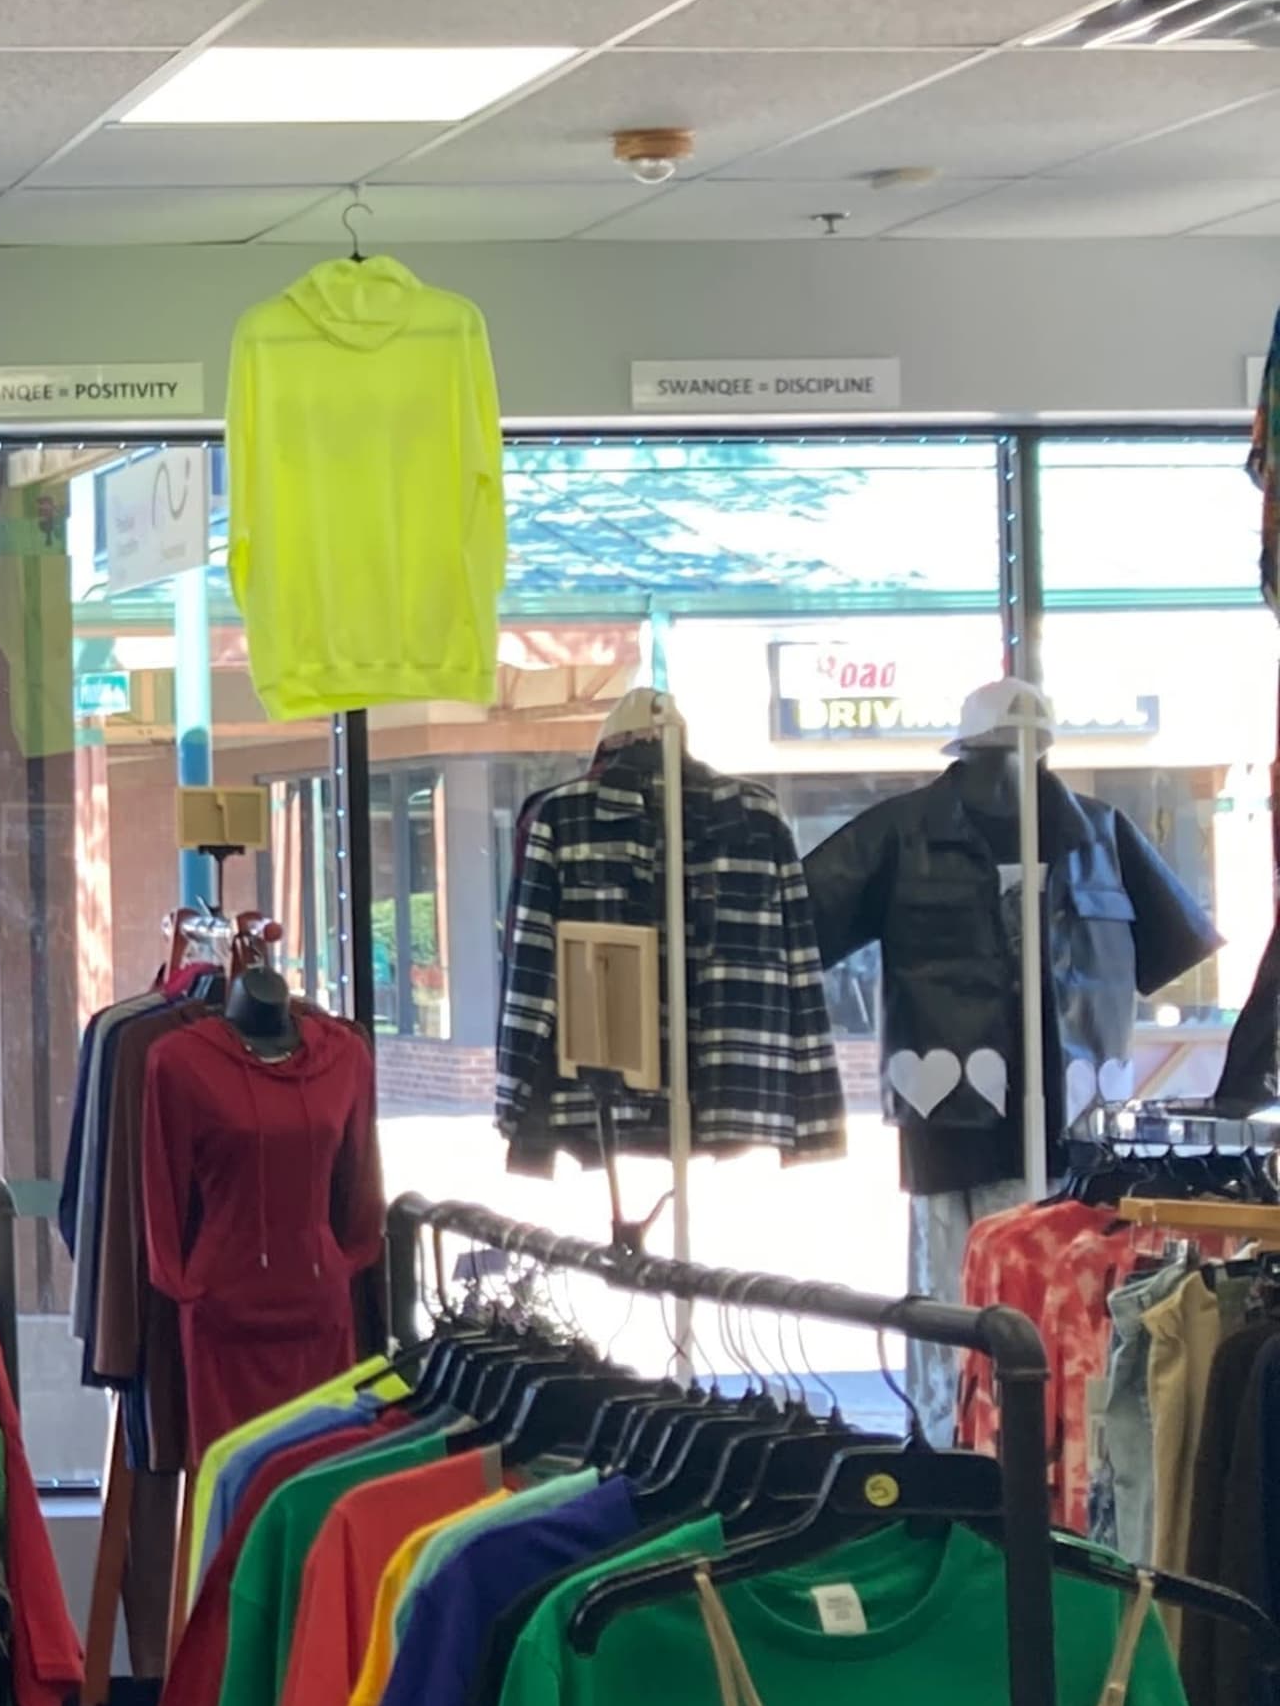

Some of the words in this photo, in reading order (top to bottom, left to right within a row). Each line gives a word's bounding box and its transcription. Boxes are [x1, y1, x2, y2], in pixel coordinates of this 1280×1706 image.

[75, 382, 178, 400] POSITIVITY
[657, 378, 752, 396] SWANQEE
[775, 376, 874, 394] DISCIPLINE
